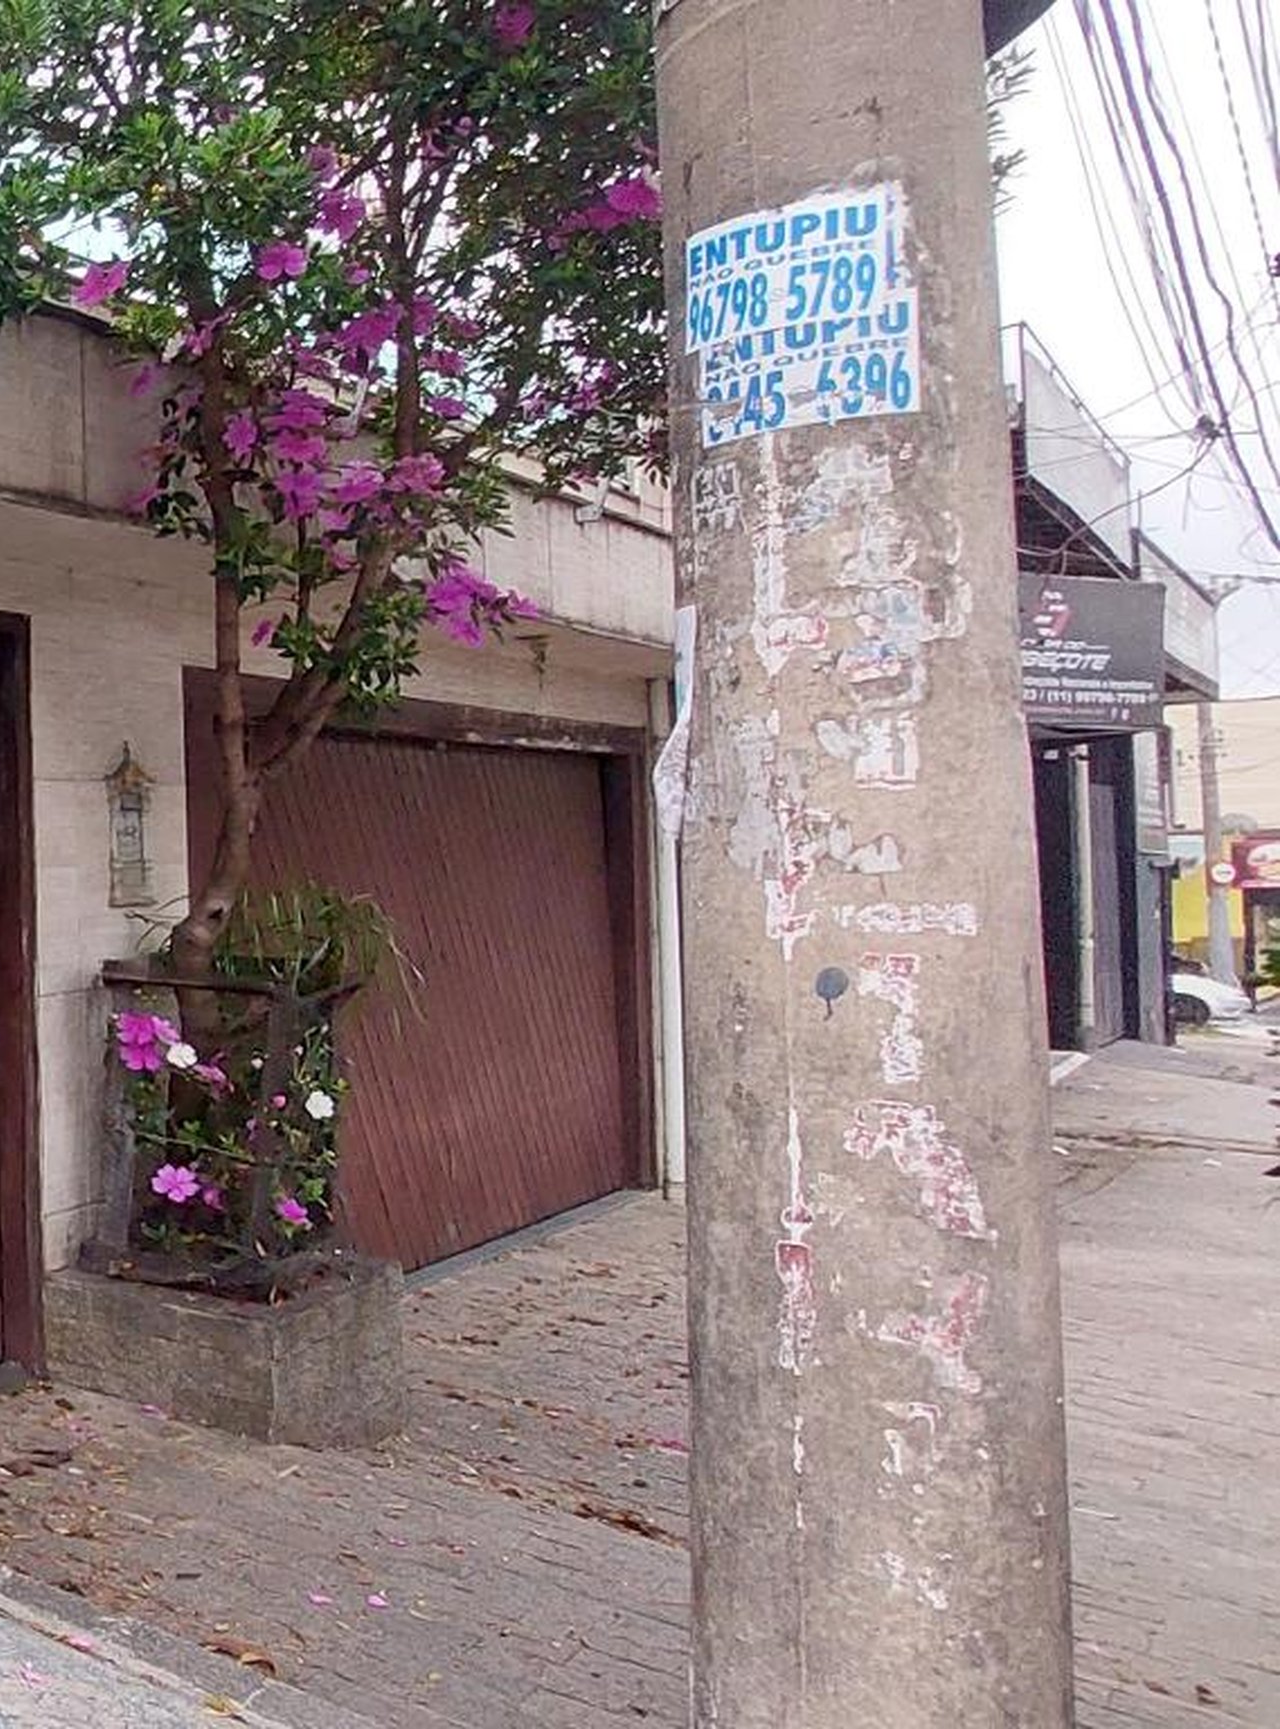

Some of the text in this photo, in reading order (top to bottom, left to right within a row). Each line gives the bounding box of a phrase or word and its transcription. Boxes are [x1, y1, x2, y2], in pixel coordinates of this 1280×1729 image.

[690, 203, 878, 278] ENTUPIU
[744, 240, 874, 271] QUEBRE
[690, 253, 877, 347] 96798 5789
[773, 337, 910, 367] QUEBRE
